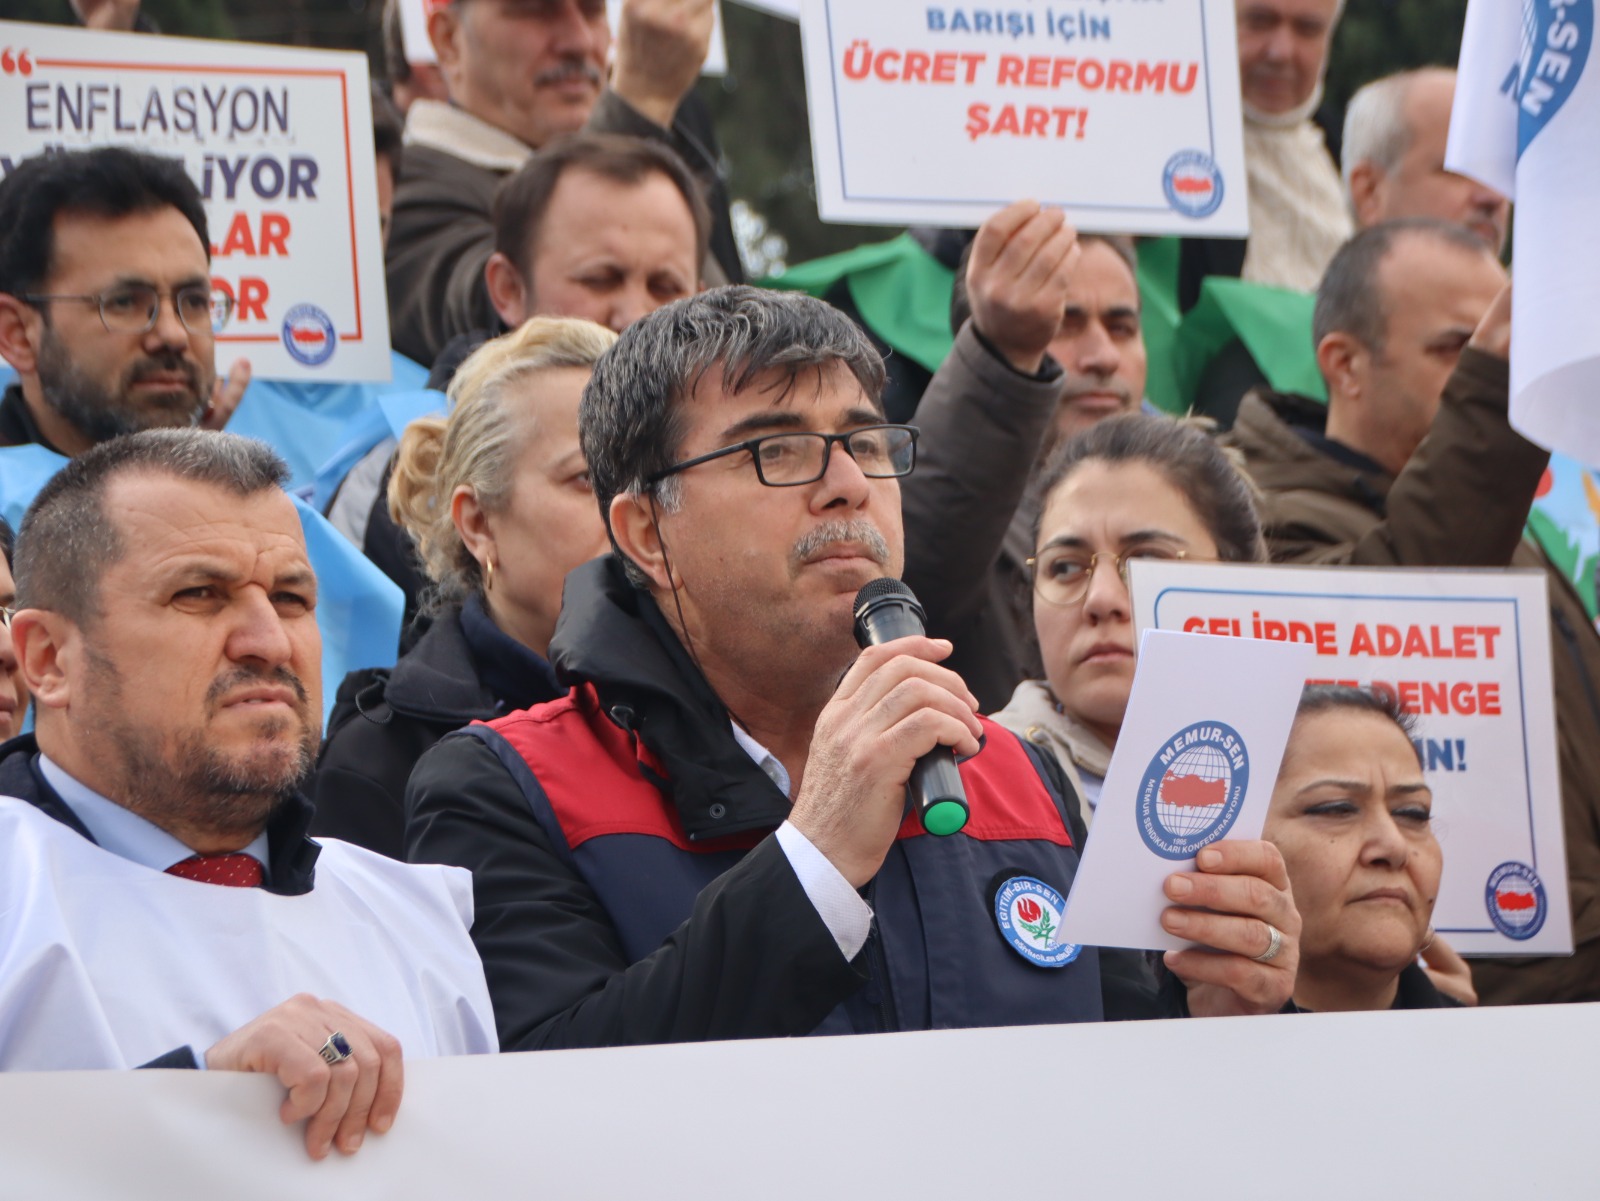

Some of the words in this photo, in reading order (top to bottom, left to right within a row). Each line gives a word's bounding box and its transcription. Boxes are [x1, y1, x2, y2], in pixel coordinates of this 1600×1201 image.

[926, 8, 1035, 39] BARIŞI
[1046, 6, 1111, 43] İÇİN
[843, 39, 986, 86] ÜCRET
[996, 54, 1199, 95] REFORMU
[26, 82, 289, 133] ENFLASYON
[965, 103, 1088, 141] ŞART!
[1349, 623, 1502, 659] ADALET
[1160, 727, 1245, 770] MEMUR-SEN
[1142, 778, 1156, 816] MEMUR
[1181, 785, 1241, 854] KONFEDERASYONU
